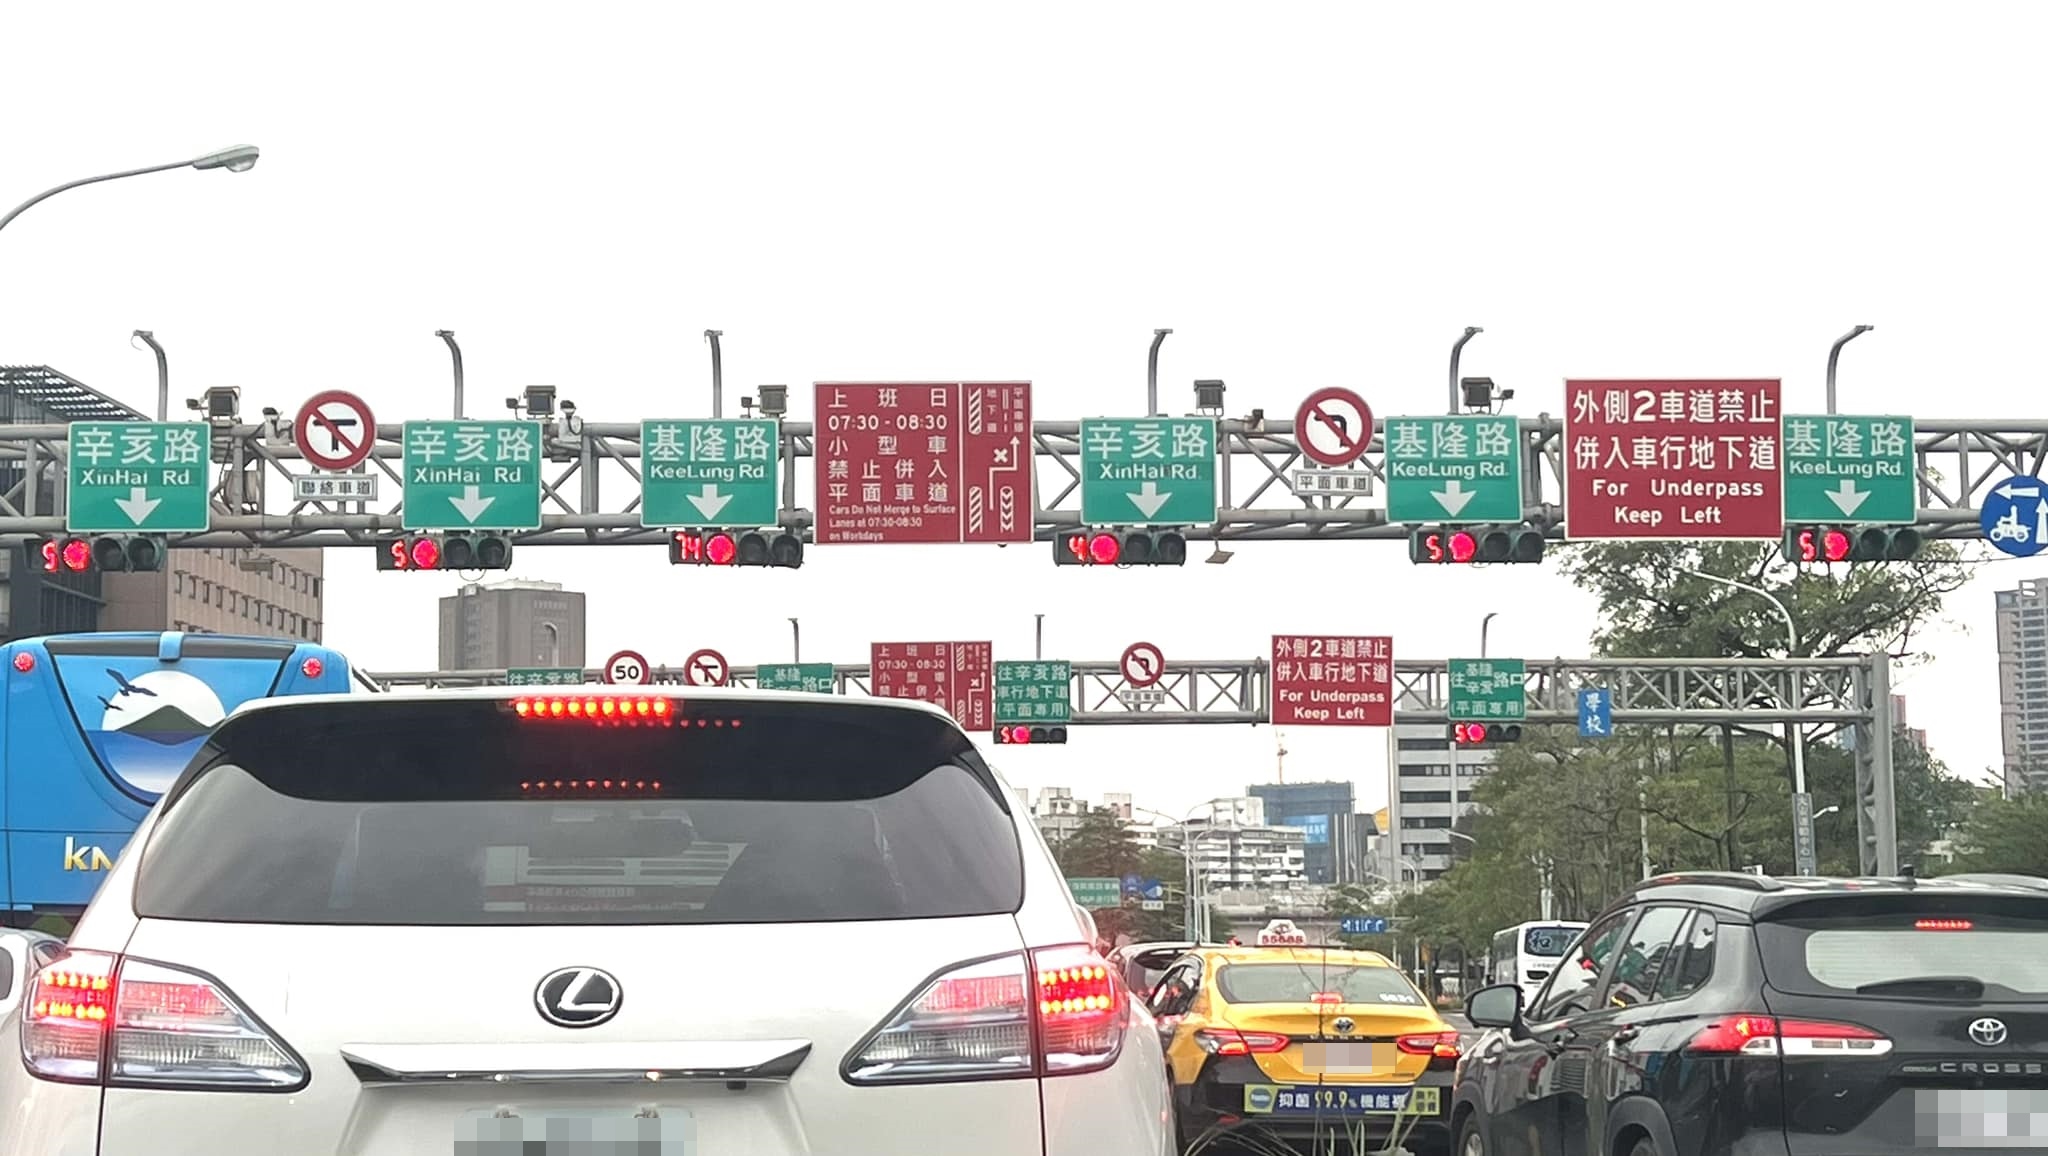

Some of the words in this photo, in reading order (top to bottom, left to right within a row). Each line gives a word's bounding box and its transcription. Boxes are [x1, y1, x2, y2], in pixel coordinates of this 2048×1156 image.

[828, 388, 947, 409] 上班日
[1573, 389, 1776, 424] 外側2車道禁止
[828, 415, 879, 431] 07:30
[896, 415, 948, 431] 08:30
[76, 427, 202, 465] 辛亥路
[409, 425, 534, 464] 辛亥路
[648, 424, 770, 463] 基隆路
[828, 435, 948, 456] 小型車
[1087, 423, 1208, 460] 辛亥路
[1391, 421, 1512, 459] 基隆路
[1785, 419, 1906, 458] 基隆路
[1573, 435, 1776, 470] 併入車行地下道
[81, 469, 147, 485] XinHai
[414, 467, 481, 483] XinHai
[651, 464, 735, 482] KeeLung
[827, 459, 948, 480] 禁止併入
[1099, 463, 1164, 480] XinHai
[1392, 462, 1475, 480] KeeLung
[1789, 461, 1873, 479] KeeLung
[301, 480, 371, 495] 聯絡車道
[1299, 477, 1366, 490] 平面車道
[1592, 479, 1629, 496] For
[1651, 479, 1764, 499] Underpass
[828, 483, 949, 503] 平面車道
[829, 504, 850, 515] Cars
[851, 504, 865, 515] Do
[866, 504, 882, 515] Not
[883, 504, 910, 518] Merge
[911, 505, 922, 515] to
[923, 504, 956, 515] Surface
[1614, 506, 1663, 526] Keep
[1680, 506, 1722, 524] Left
[829, 517, 855, 528] Lanes
[856, 517, 866, 528] at
[829, 533, 840, 541] on
[842, 530, 884, 543] Workdays
[1276, 639, 1388, 659] 外側2車道禁止
[615, 665, 640, 680] 50
[878, 660, 908, 669] 07:30
[916, 660, 946, 669] 08:30
[998, 664, 1067, 682] 往辛亥路
[1276, 662, 1388, 683] 併入車行地下道
[998, 684, 1068, 699] 車行地下道
[1279, 690, 1303, 702] For
[1311, 690, 1385, 704] Underpass
[1294, 707, 1329, 720] Keep
[1337, 707, 1365, 720] Left
[1585, 693, 1605, 734] 學校
